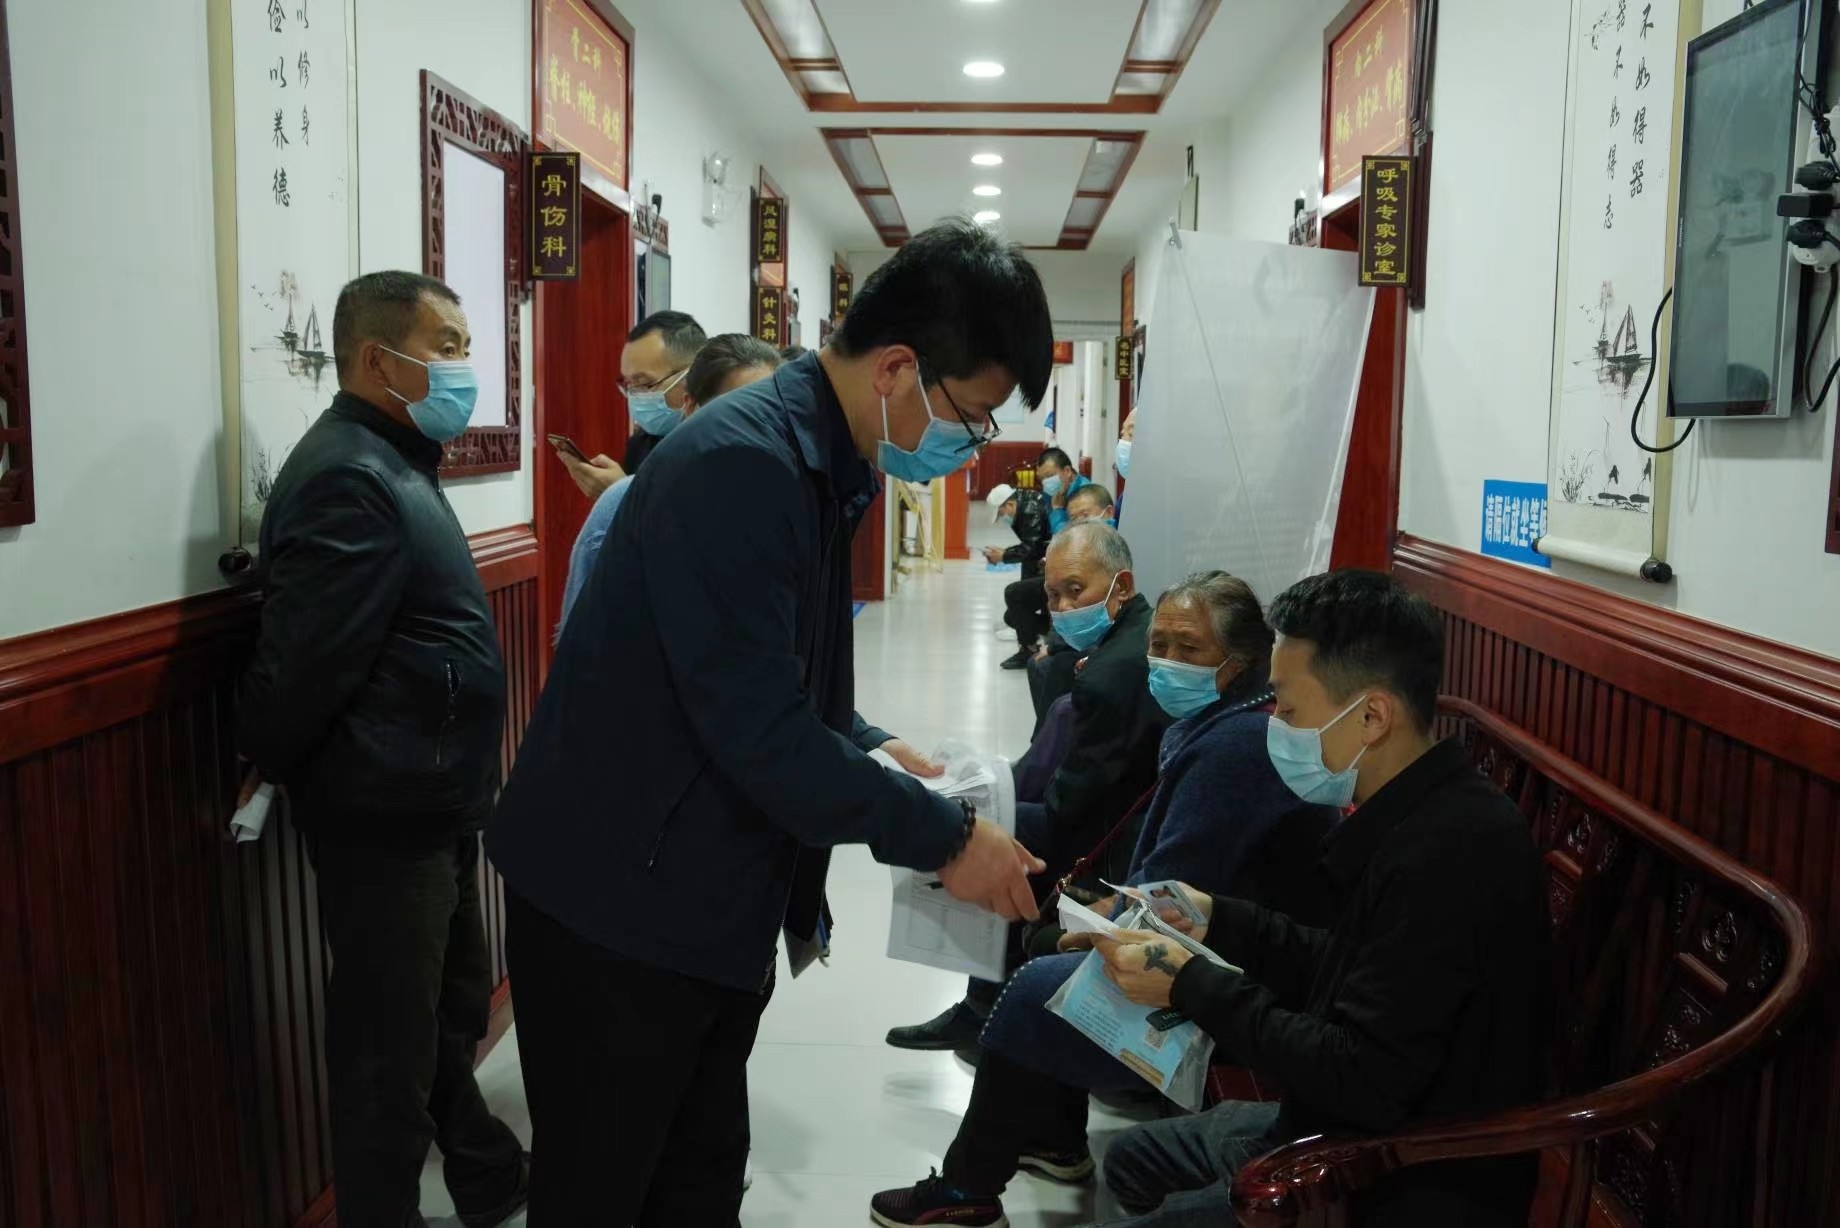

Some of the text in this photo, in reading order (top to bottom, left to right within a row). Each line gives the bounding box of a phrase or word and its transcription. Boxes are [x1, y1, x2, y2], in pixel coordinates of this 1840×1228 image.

[541, 174, 568, 258] 骨伤科
[762, 206, 778, 255] 风湿病科
[1374, 168, 1399, 275] 呼吸专家诊室
[762, 296, 777, 340] 针灸科
